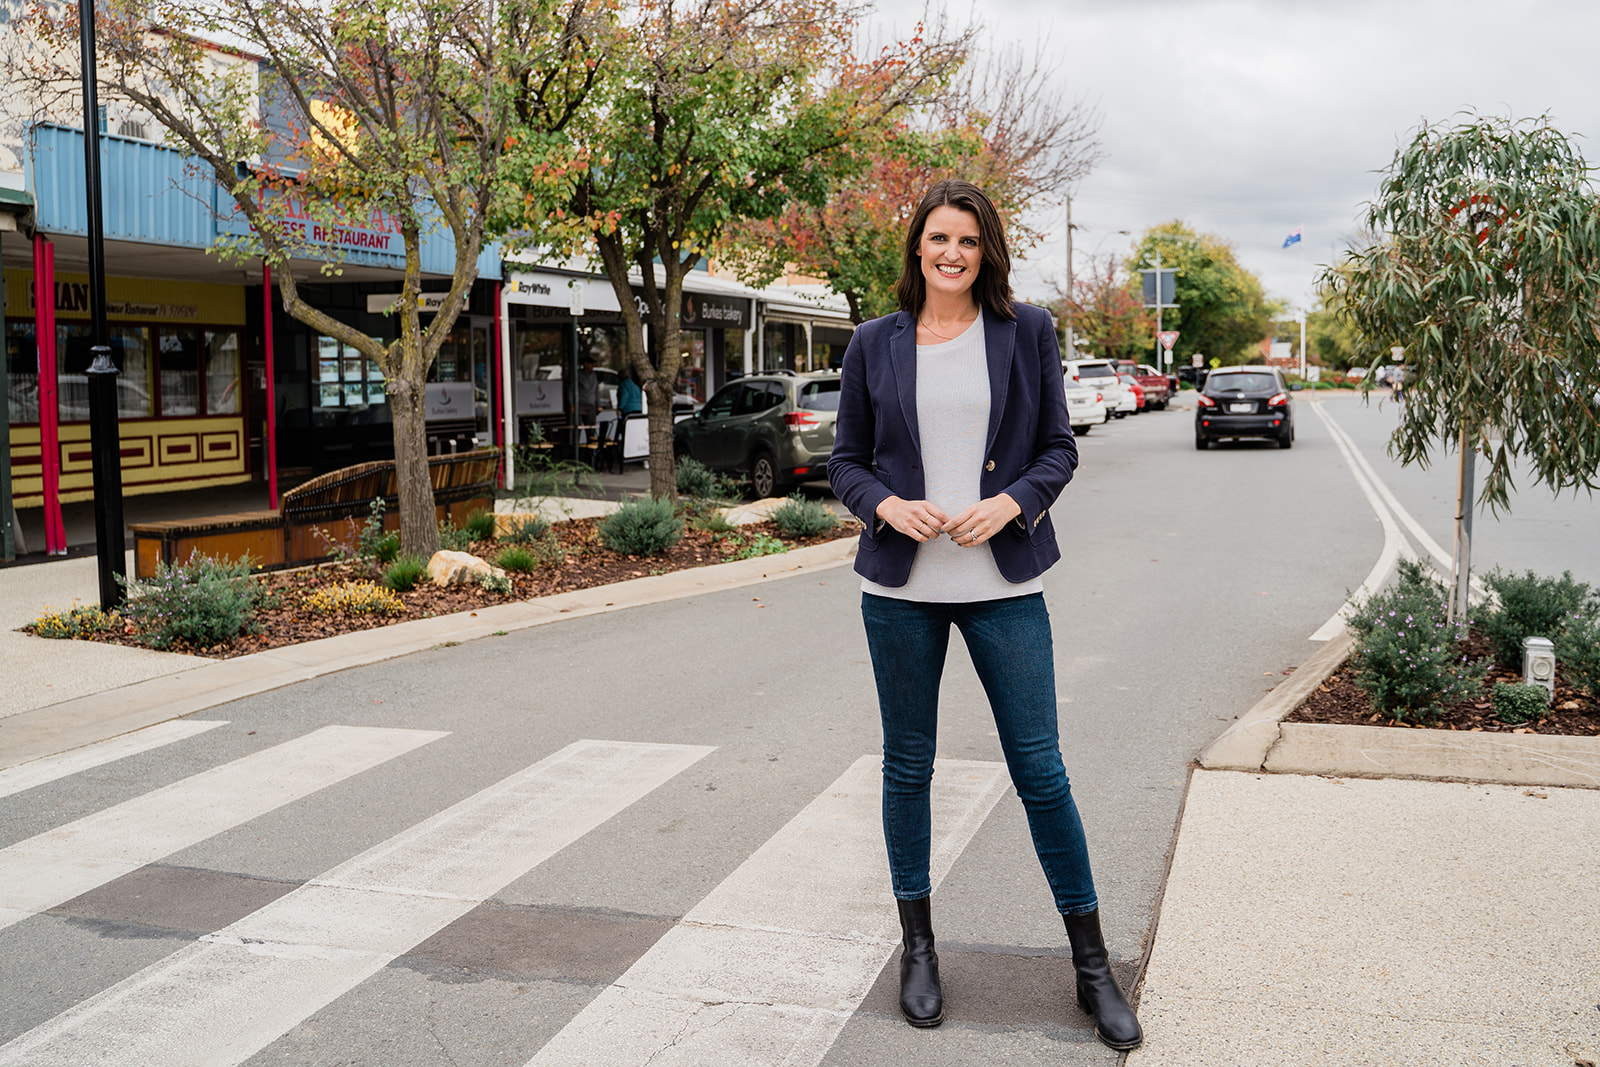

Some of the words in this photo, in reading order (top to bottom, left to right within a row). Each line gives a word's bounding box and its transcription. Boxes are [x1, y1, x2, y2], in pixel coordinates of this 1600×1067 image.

[31, 282, 89, 313] AN
[533, 306, 570, 318] Burke
[584, 309, 623, 321] akery
